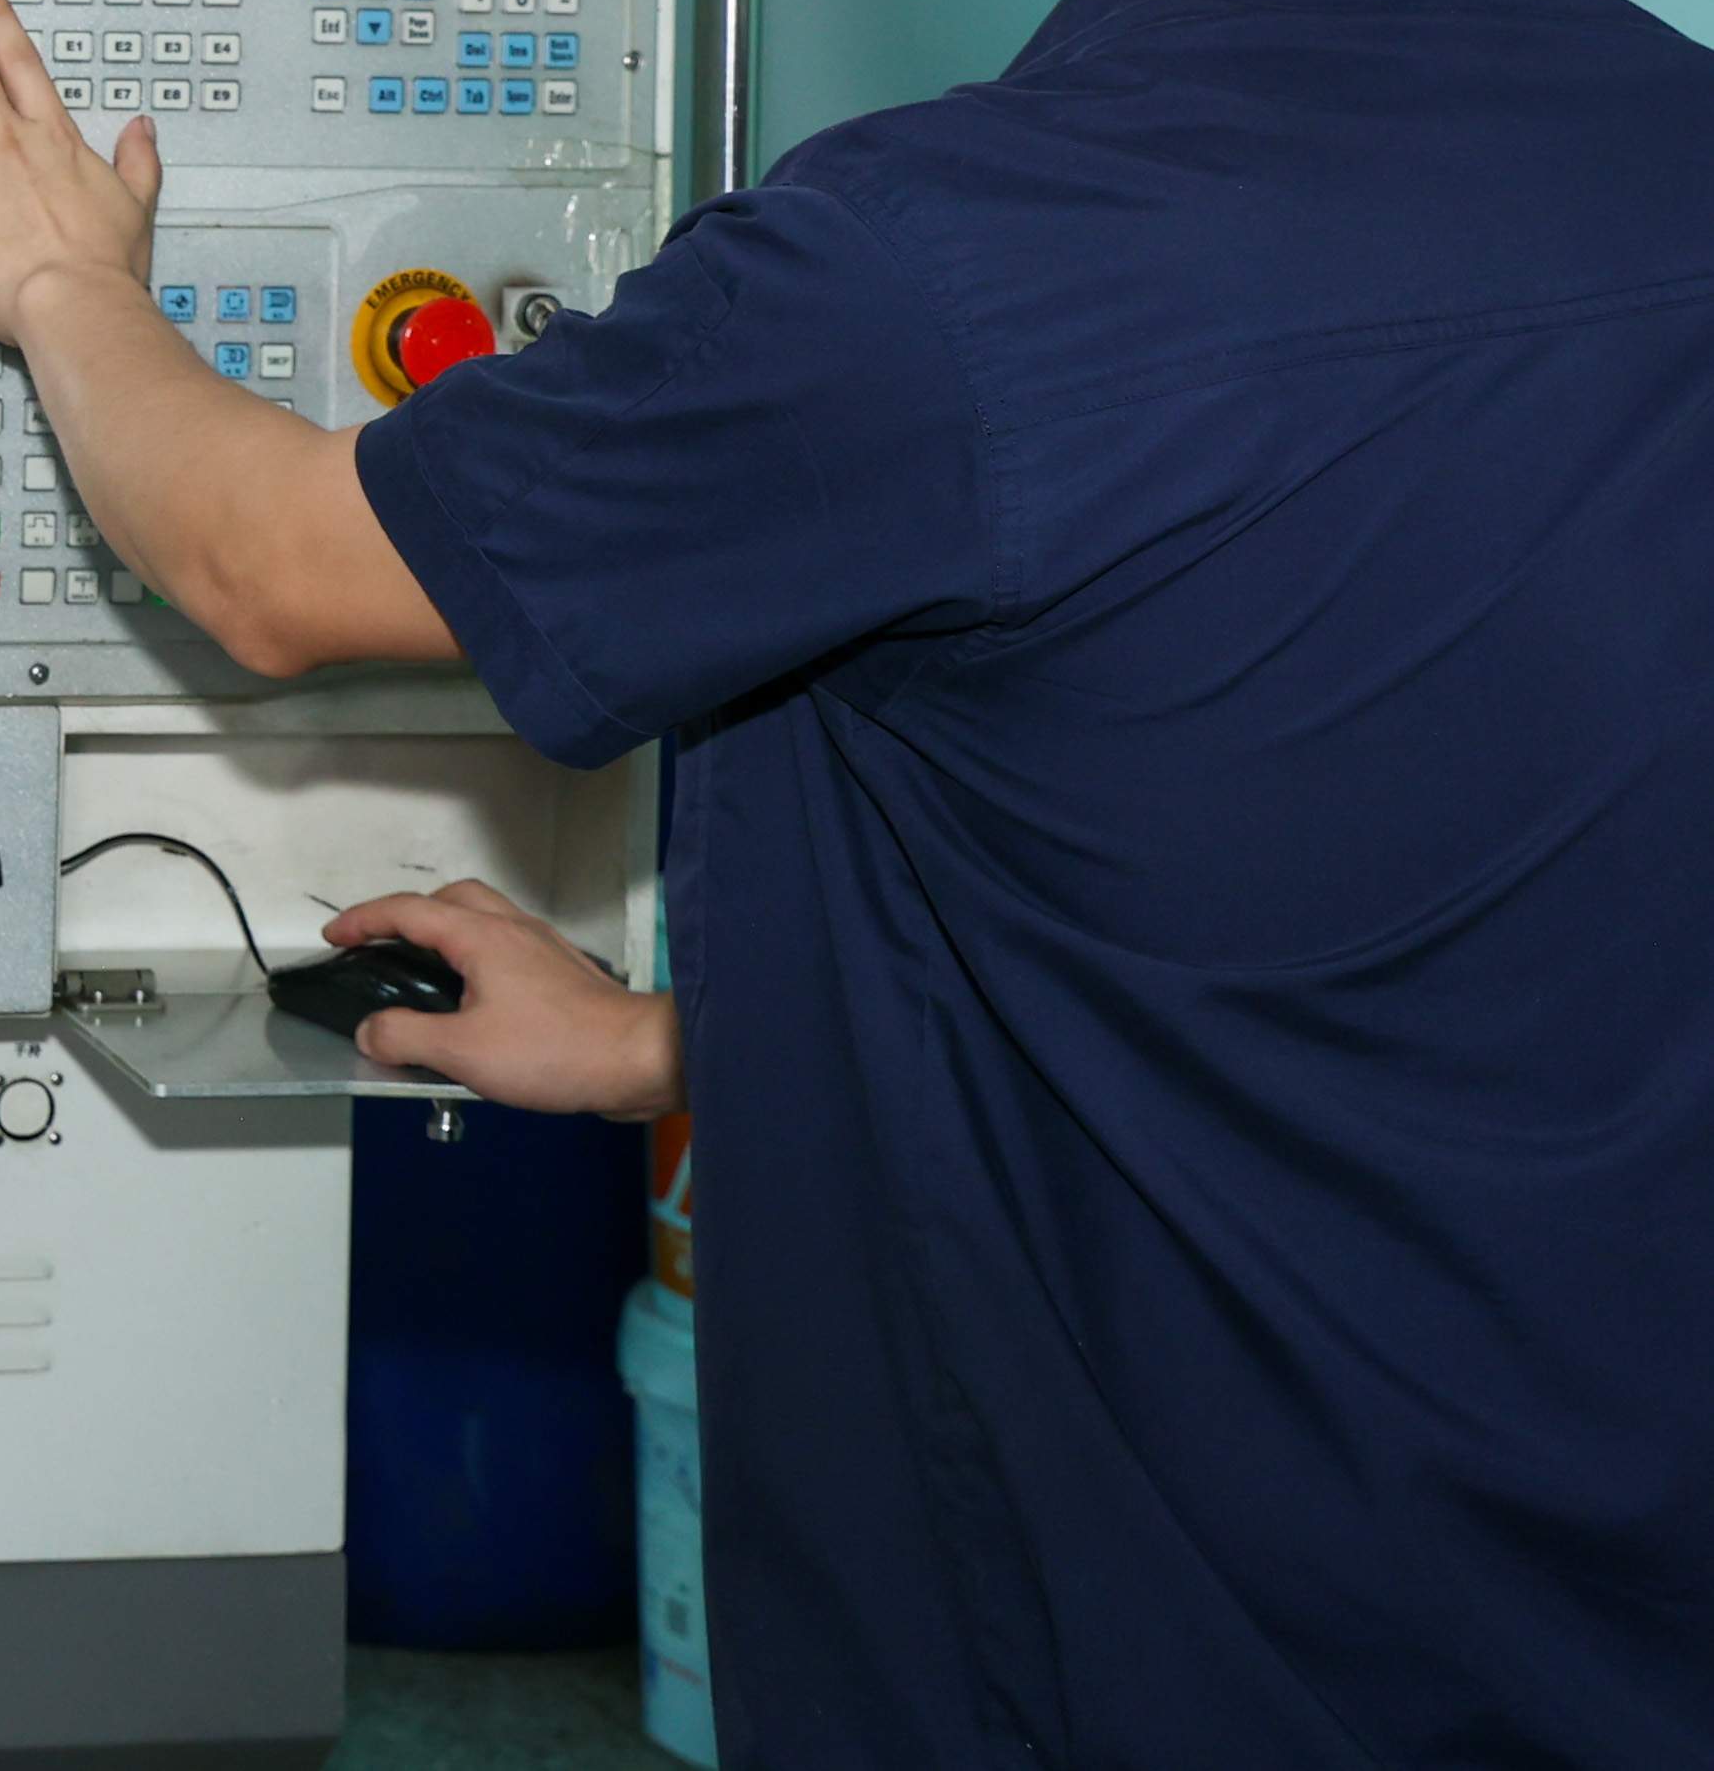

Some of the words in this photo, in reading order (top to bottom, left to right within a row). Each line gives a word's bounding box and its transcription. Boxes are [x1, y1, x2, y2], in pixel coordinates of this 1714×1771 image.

[66, 41, 84, 53] E1
[115, 41, 133, 53] E2
[164, 42, 182, 54] E3
[214, 42, 231, 55] E4
[64, 88, 83, 100] E6
[113, 89, 132, 101] E7
[163, 90, 181, 102] E8
[213, 90, 230, 102] E9
[319, 90, 339, 100] Esc
